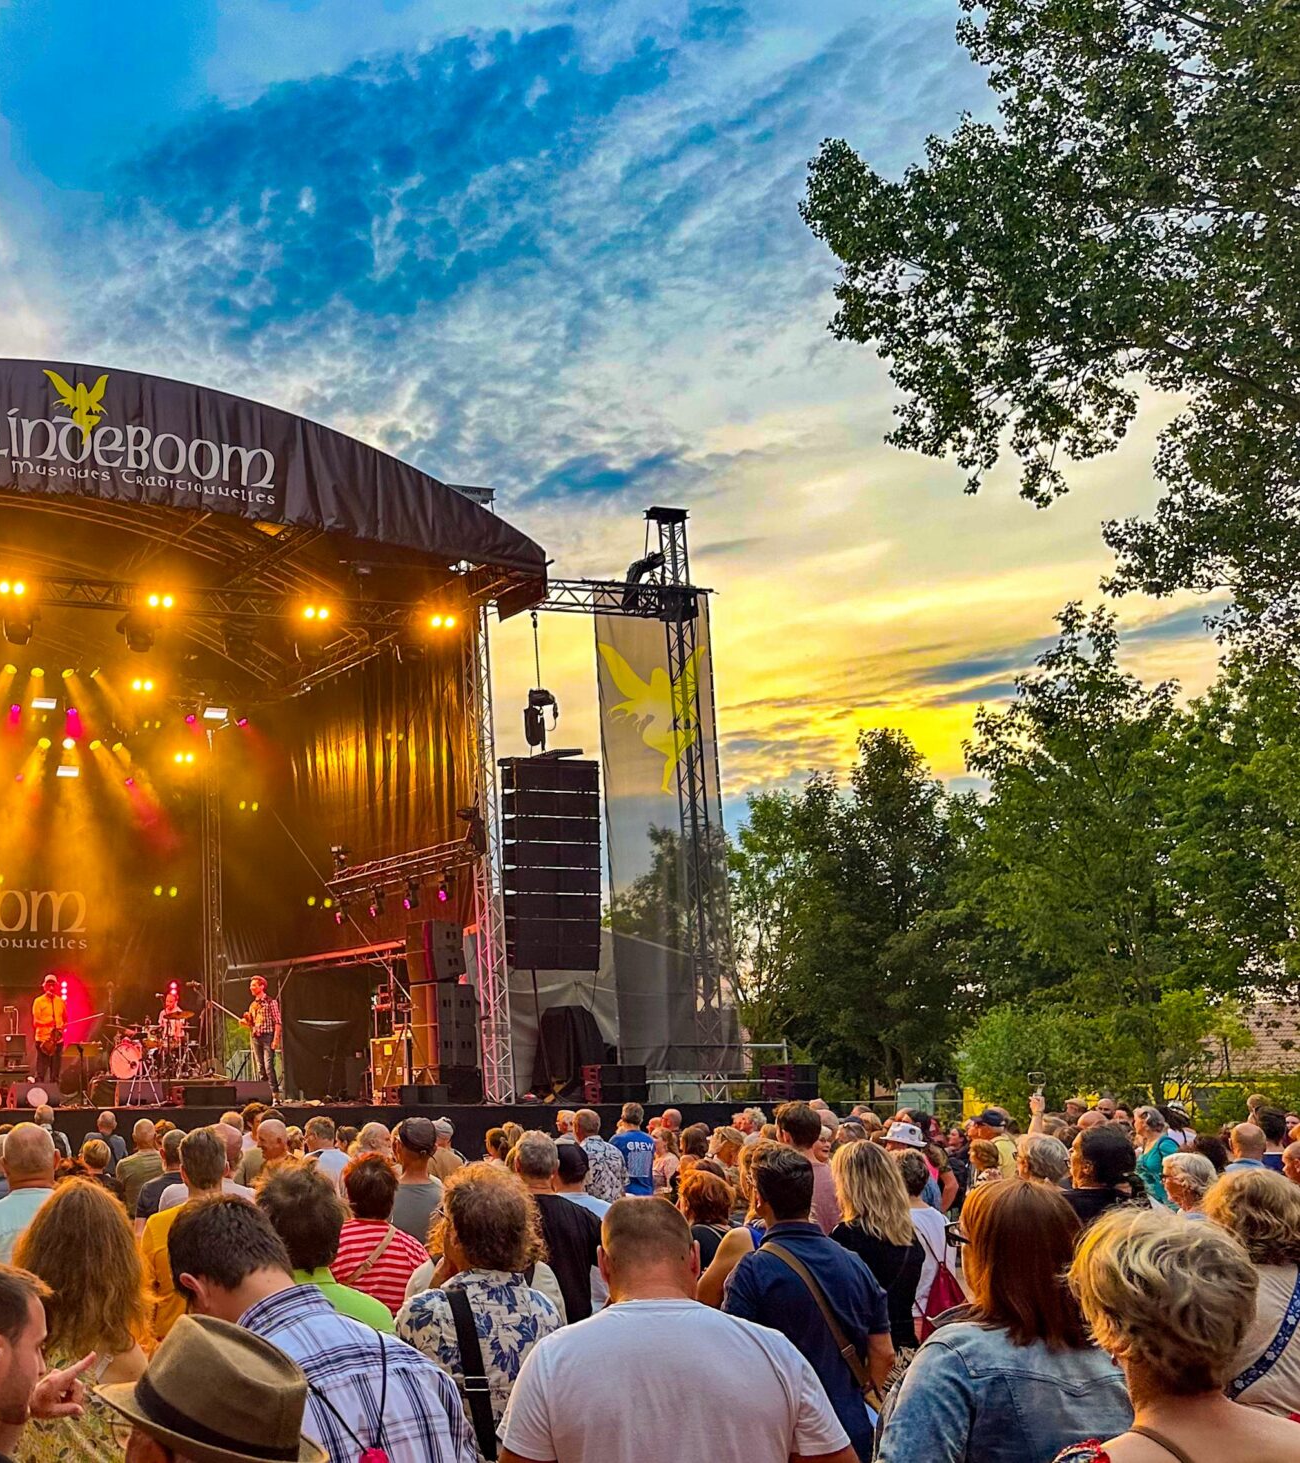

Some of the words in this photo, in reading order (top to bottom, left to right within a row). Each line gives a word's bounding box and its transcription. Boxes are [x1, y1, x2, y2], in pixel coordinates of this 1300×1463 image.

[11, 460, 111, 482] Musiques
[120, 468, 276, 505] Traditionnelles
[626, 1141, 654, 1151] CREW
